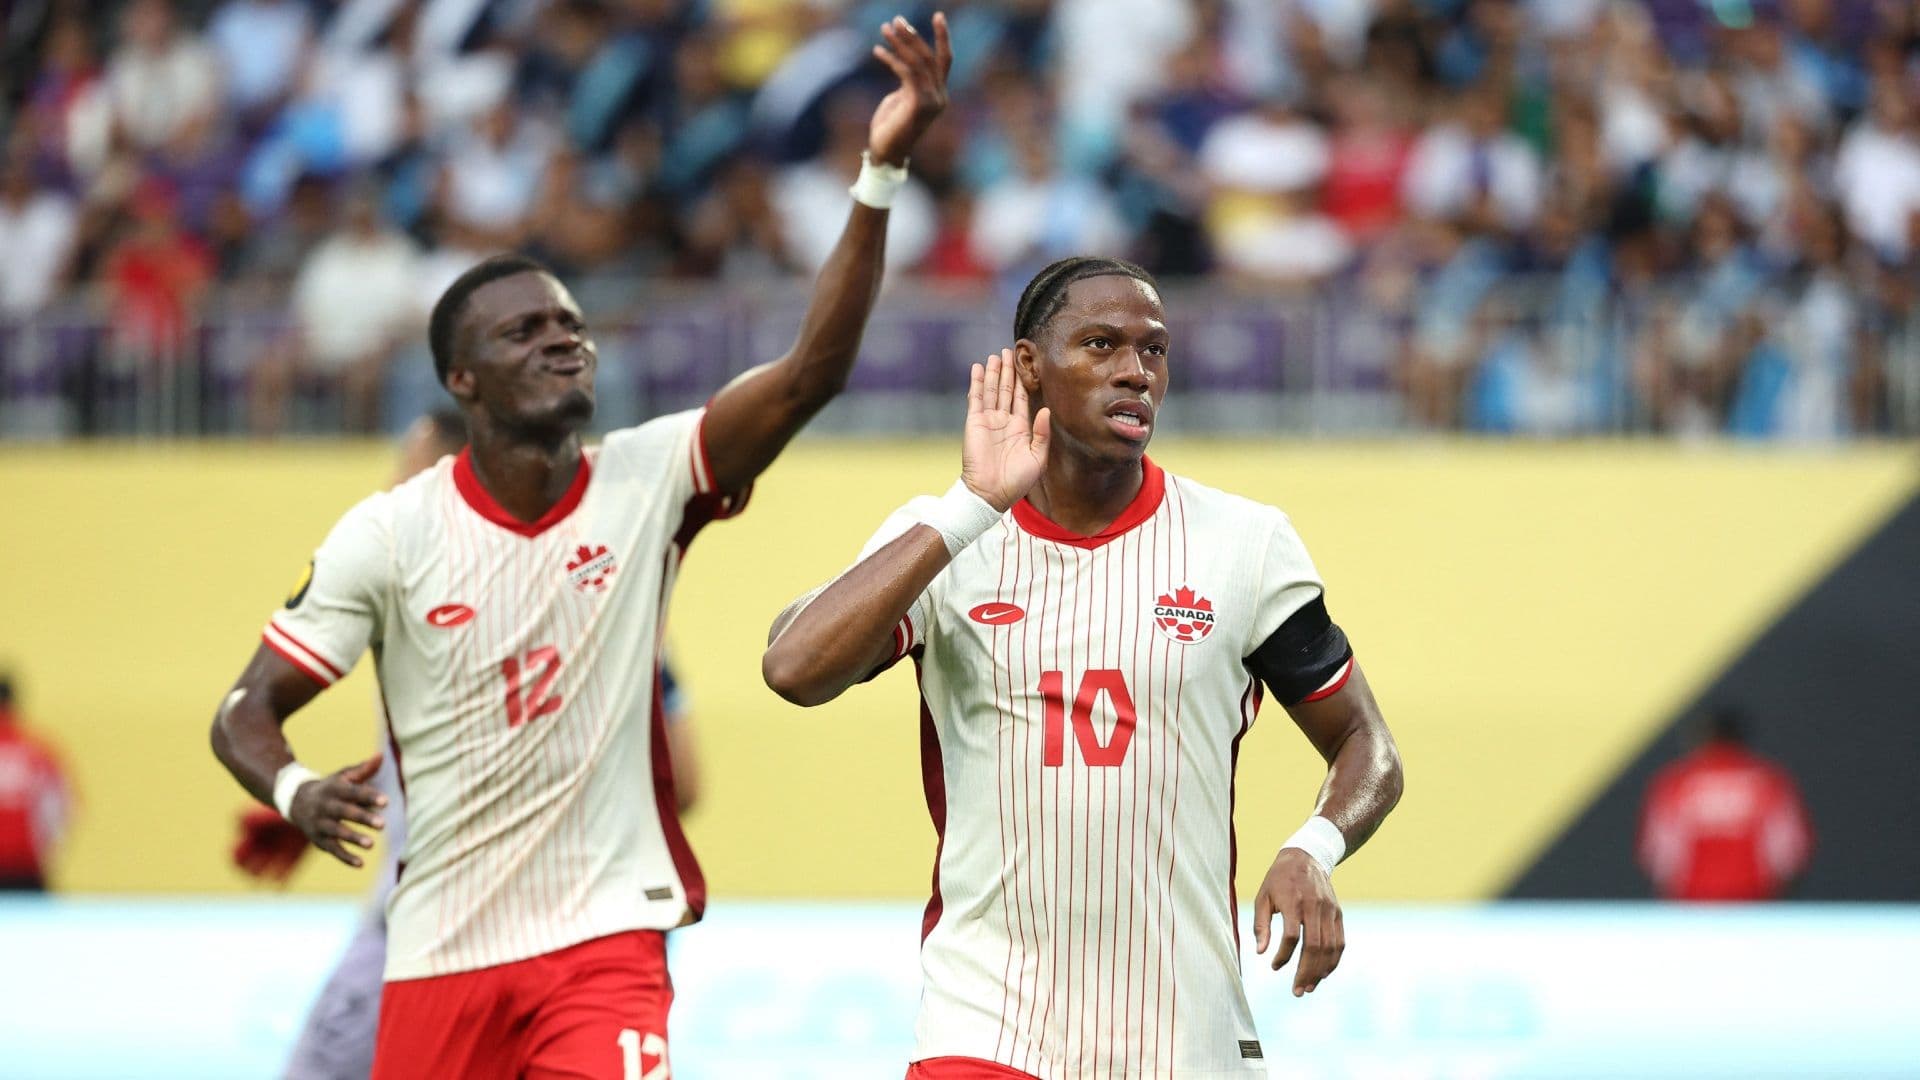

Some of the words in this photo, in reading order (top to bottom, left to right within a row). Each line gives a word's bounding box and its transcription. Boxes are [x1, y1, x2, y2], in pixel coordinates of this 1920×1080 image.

[1154, 607, 1215, 623] CANADA
[502, 644, 563, 729] 12
[1037, 669, 1138, 767] 10
[617, 1028, 670, 1080] 12
